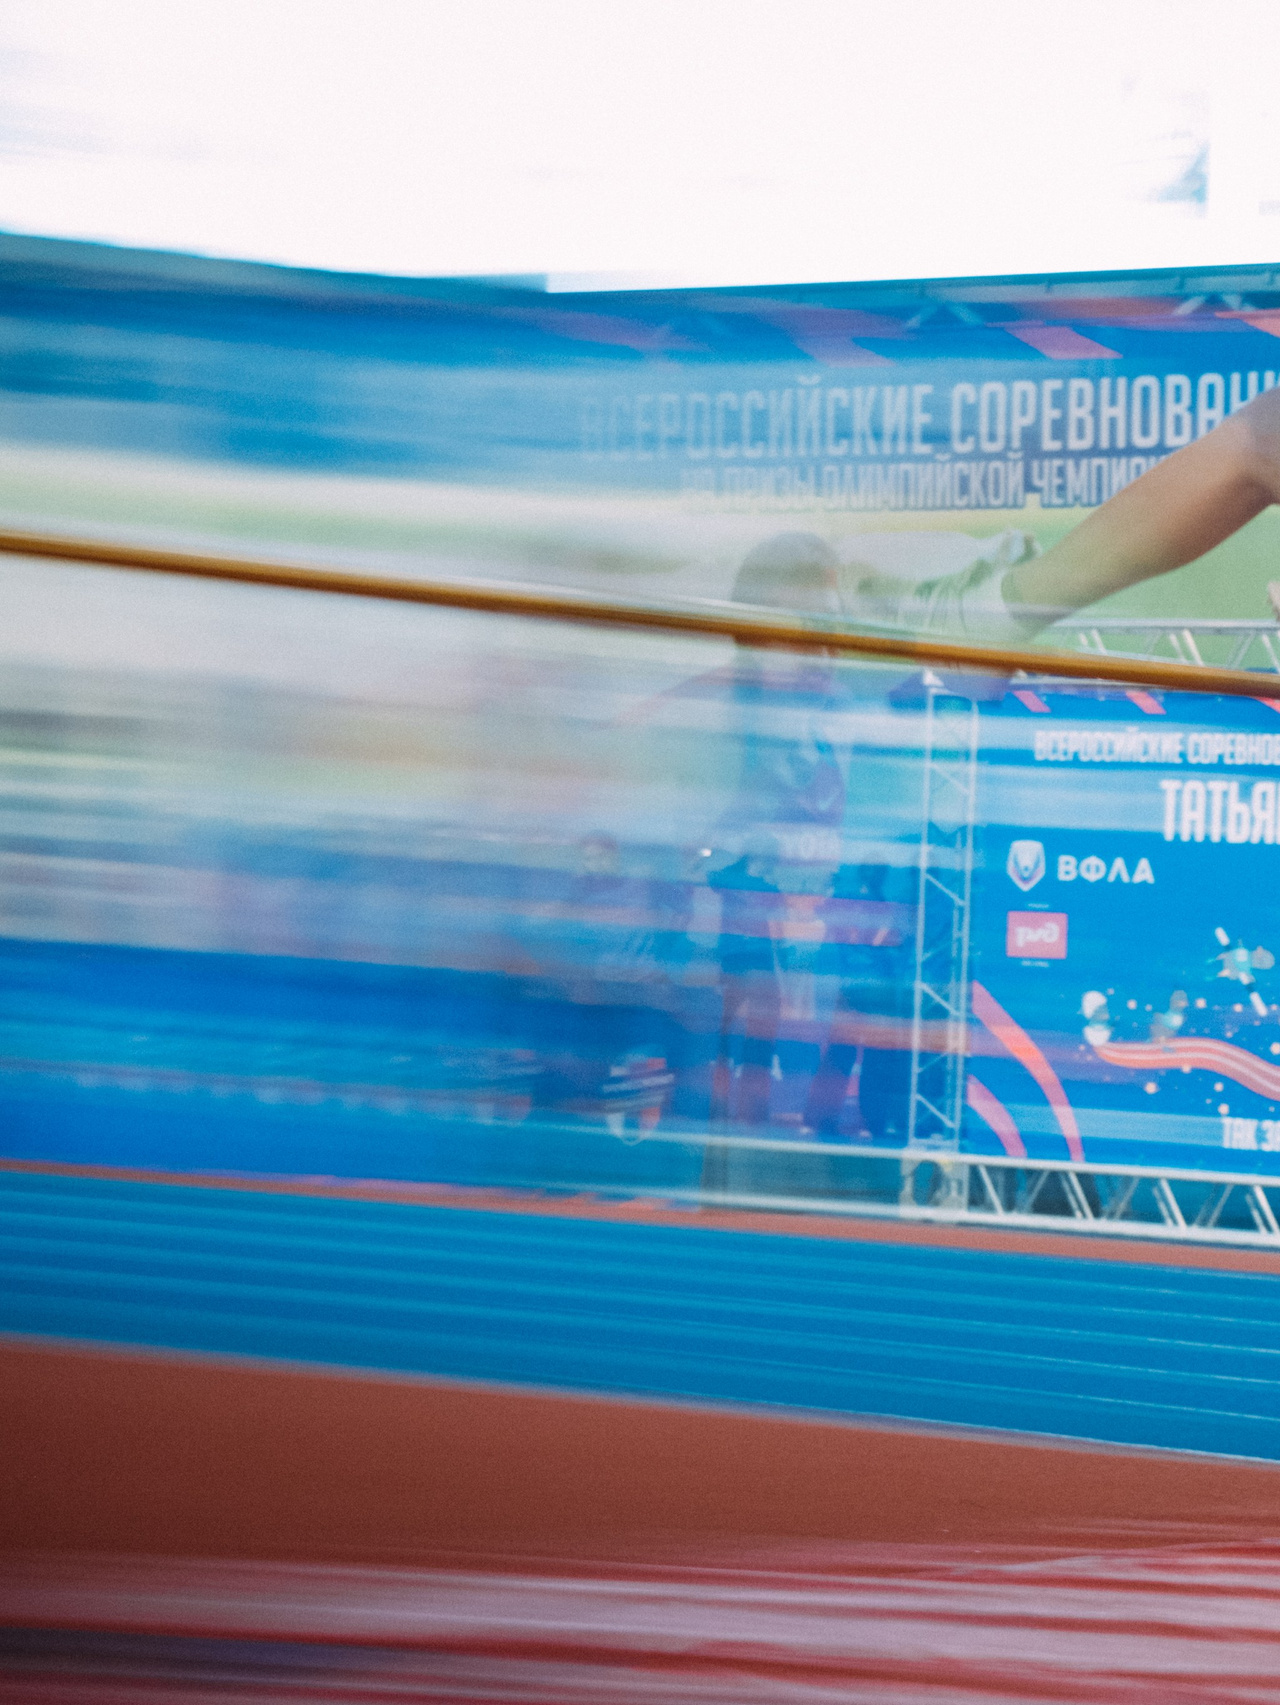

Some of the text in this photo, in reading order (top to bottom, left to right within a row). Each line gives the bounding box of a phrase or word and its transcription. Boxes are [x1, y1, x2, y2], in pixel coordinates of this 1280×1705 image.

[579, 373, 934, 461] ВСЕРОССИЙСКИЕ
[823, 452, 1024, 510] ОЛИМПИЙСКОЙ
[1034, 725, 1185, 764] ВСЕРОССИЙСКИЕ
[1057, 854, 1156, 885] ВФЛА
[1221, 1116, 1259, 1151] ТАК
